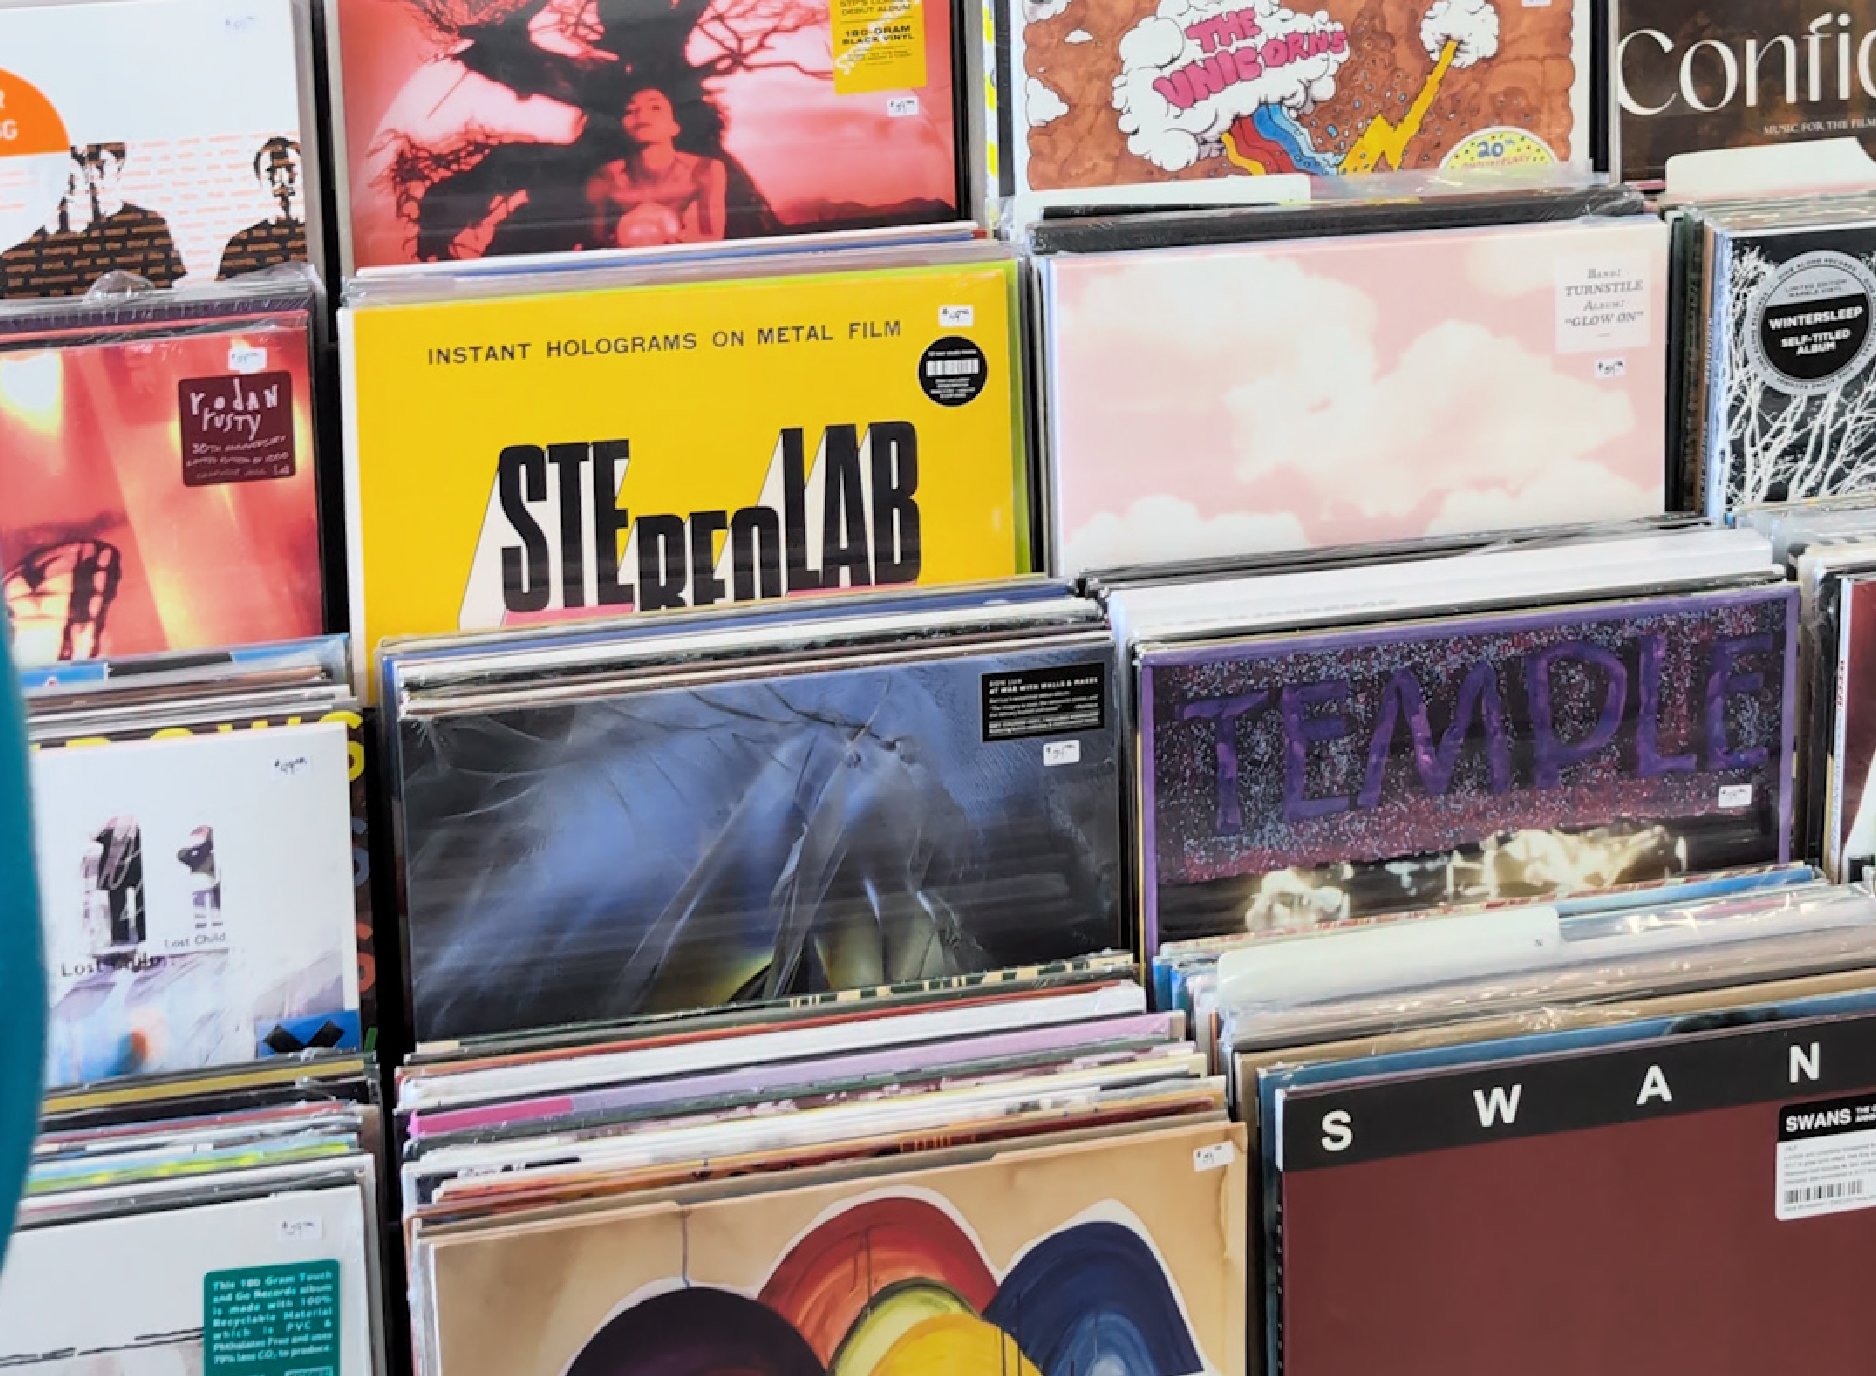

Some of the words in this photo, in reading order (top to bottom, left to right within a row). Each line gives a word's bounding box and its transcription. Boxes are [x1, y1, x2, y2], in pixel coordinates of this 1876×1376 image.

[1186, 7, 1262, 53] THE
[1152, 30, 1349, 110] UNICORNS
[1563, 279, 1644, 297] TURNSTILE
[1768, 305, 1862, 330] WINTERSLEEP
[428, 343, 531, 365] INSTANT
[546, 333, 697, 358] HOLOGRAMS
[712, 330, 745, 348] ON
[757, 325, 833, 345] METAL
[848, 320, 900, 339] FILM
[1780, 328, 1851, 347] SELF-TITLED
[1796, 341, 1836, 355] ALBUM
[499, 420, 921, 612] STEREOLAB
[1176, 633, 1772, 834] TEMPLE
[1785, 1107, 1851, 1132] SWANS
[228, 1303, 261, 1315] made
[283, 1306, 332, 1320] Material
[286, 1320, 311, 1332] PVC
